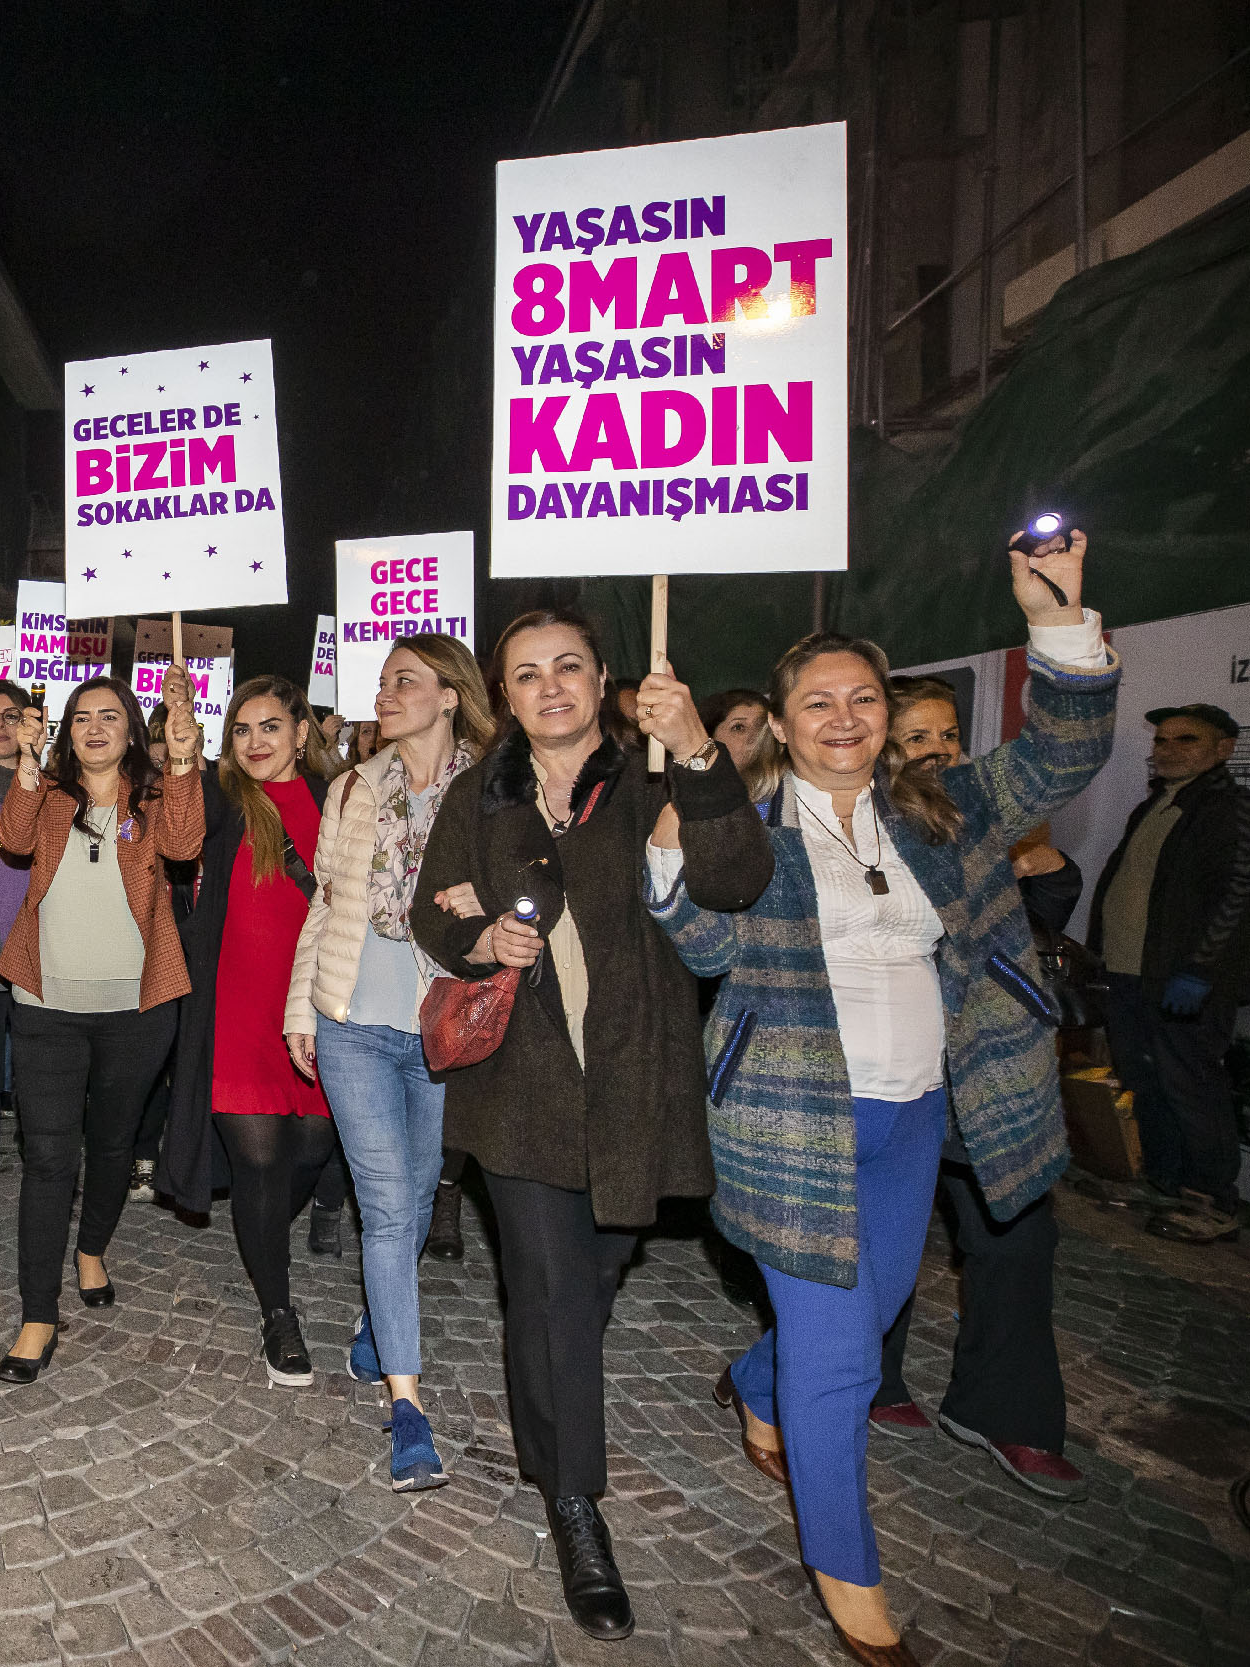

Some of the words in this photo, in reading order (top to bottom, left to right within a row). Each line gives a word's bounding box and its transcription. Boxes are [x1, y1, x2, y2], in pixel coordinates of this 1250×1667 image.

[512, 195, 726, 255] YAŞASIN
[511, 238, 832, 337] 8MART
[510, 332, 726, 389] YAŞASIN
[73, 408, 197, 442] GECELER
[203, 402, 241, 428] DE
[509, 380, 813, 474] KADIN
[77, 492, 228, 527] SOKAKLAR
[235, 487, 275, 513] DA
[508, 472, 808, 522] DAYANIŞMASI
[370, 557, 438, 584] GECE
[370, 589, 438, 616] GECE
[20, 633, 108, 657] NAMUSU
[317, 647, 337, 660] DE
[19, 655, 105, 682] DEĞİLİZ
[197, 658, 214, 670] DE
[314, 661, 333, 676] KA
[205, 703, 223, 716] DA
